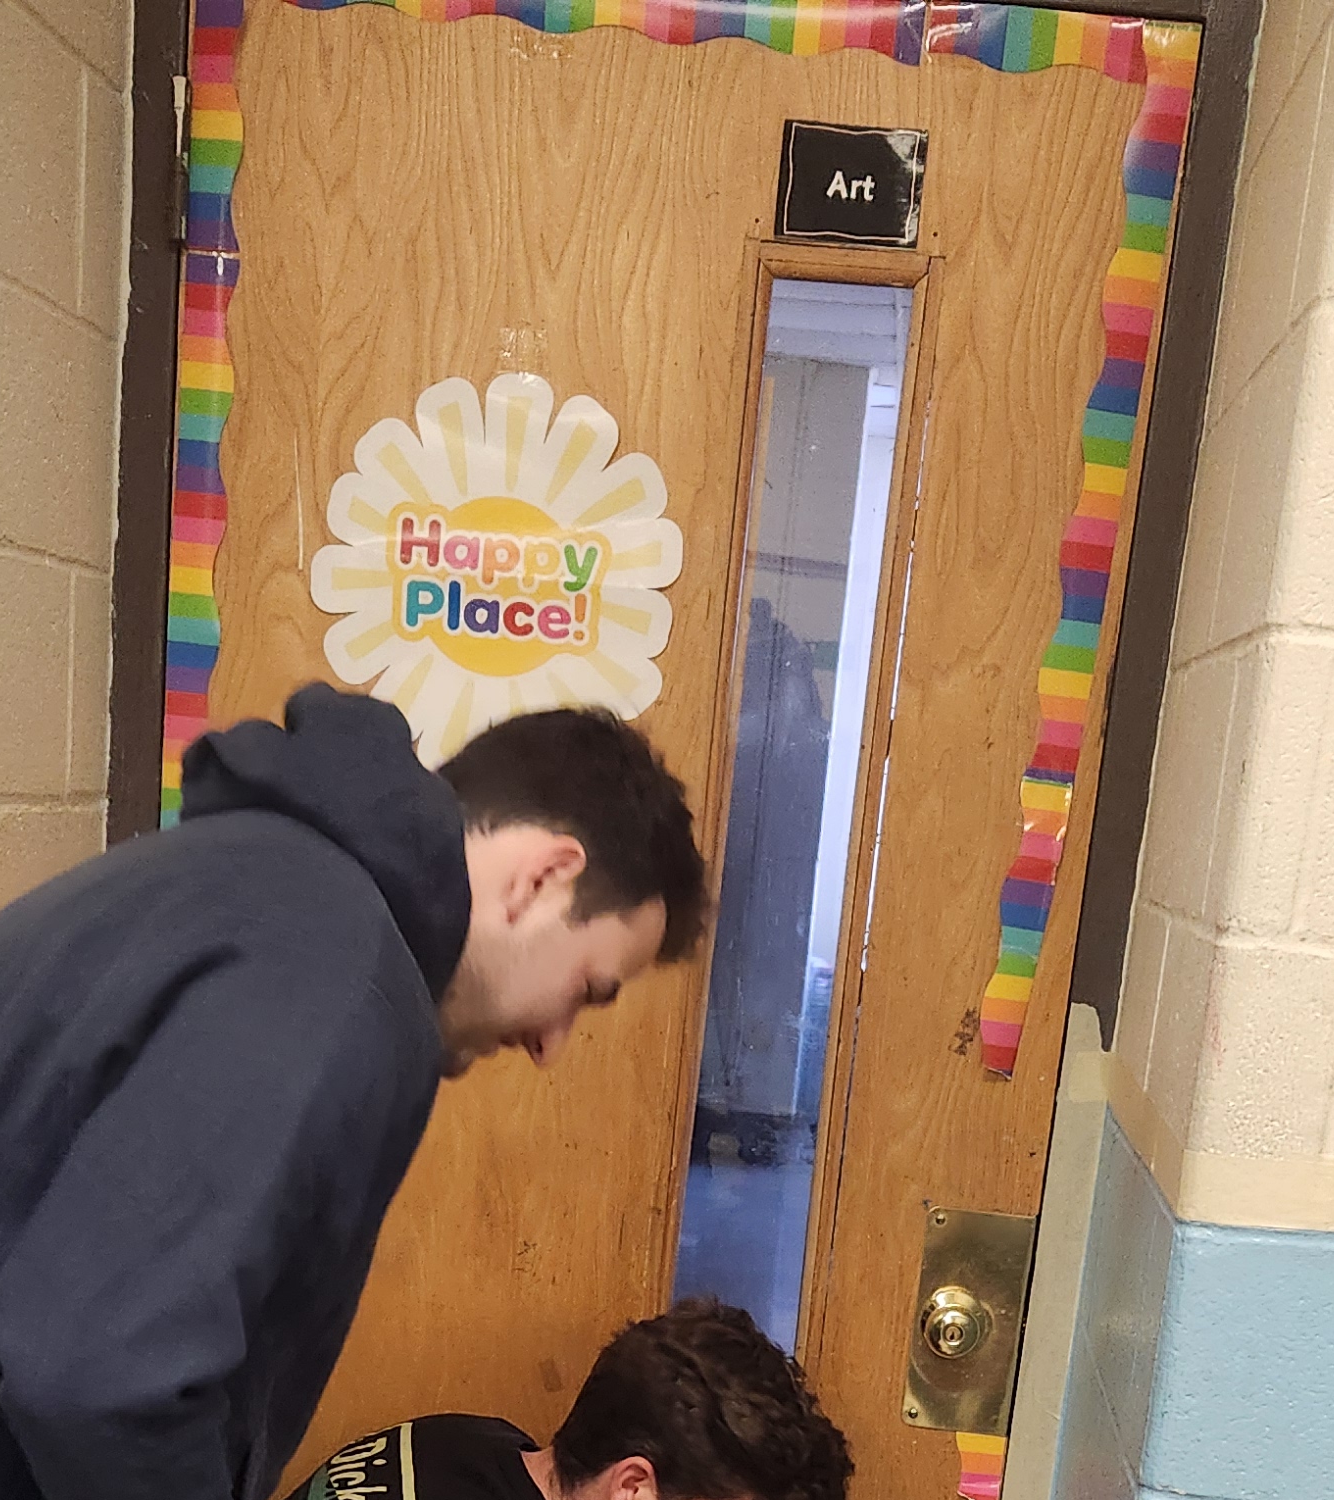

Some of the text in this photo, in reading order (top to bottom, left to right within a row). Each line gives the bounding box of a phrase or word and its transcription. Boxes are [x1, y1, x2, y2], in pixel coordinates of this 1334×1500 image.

[826, 169, 876, 202] Art
[398, 516, 599, 593] Happy
[404, 579, 588, 642] Place!
